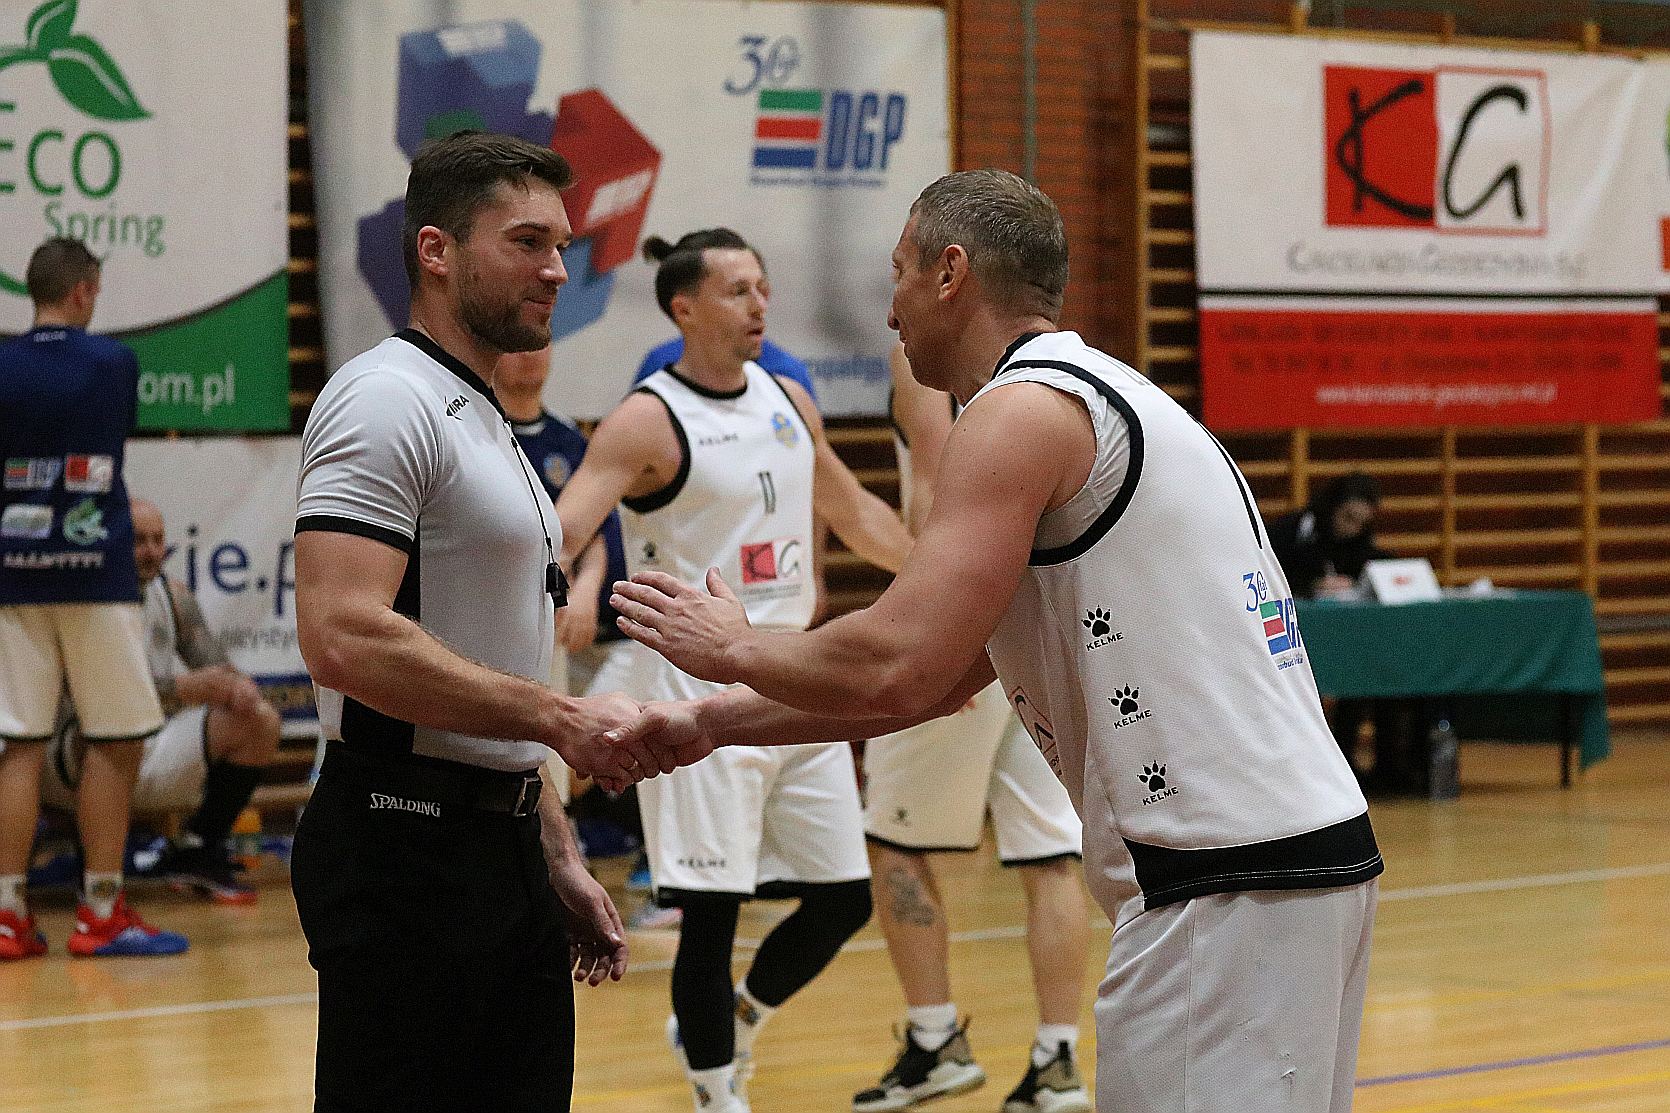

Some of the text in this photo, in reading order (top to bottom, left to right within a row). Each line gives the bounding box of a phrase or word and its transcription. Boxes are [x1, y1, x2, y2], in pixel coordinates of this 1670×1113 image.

[825, 91, 906, 171] DGP
[45, 199, 167, 257] Spring
[1086, 632, 1124, 651] KELME
[1113, 709, 1152, 730] KELME
[370, 792, 441, 818] SPALDING
[1142, 787, 1179, 806] KELME
